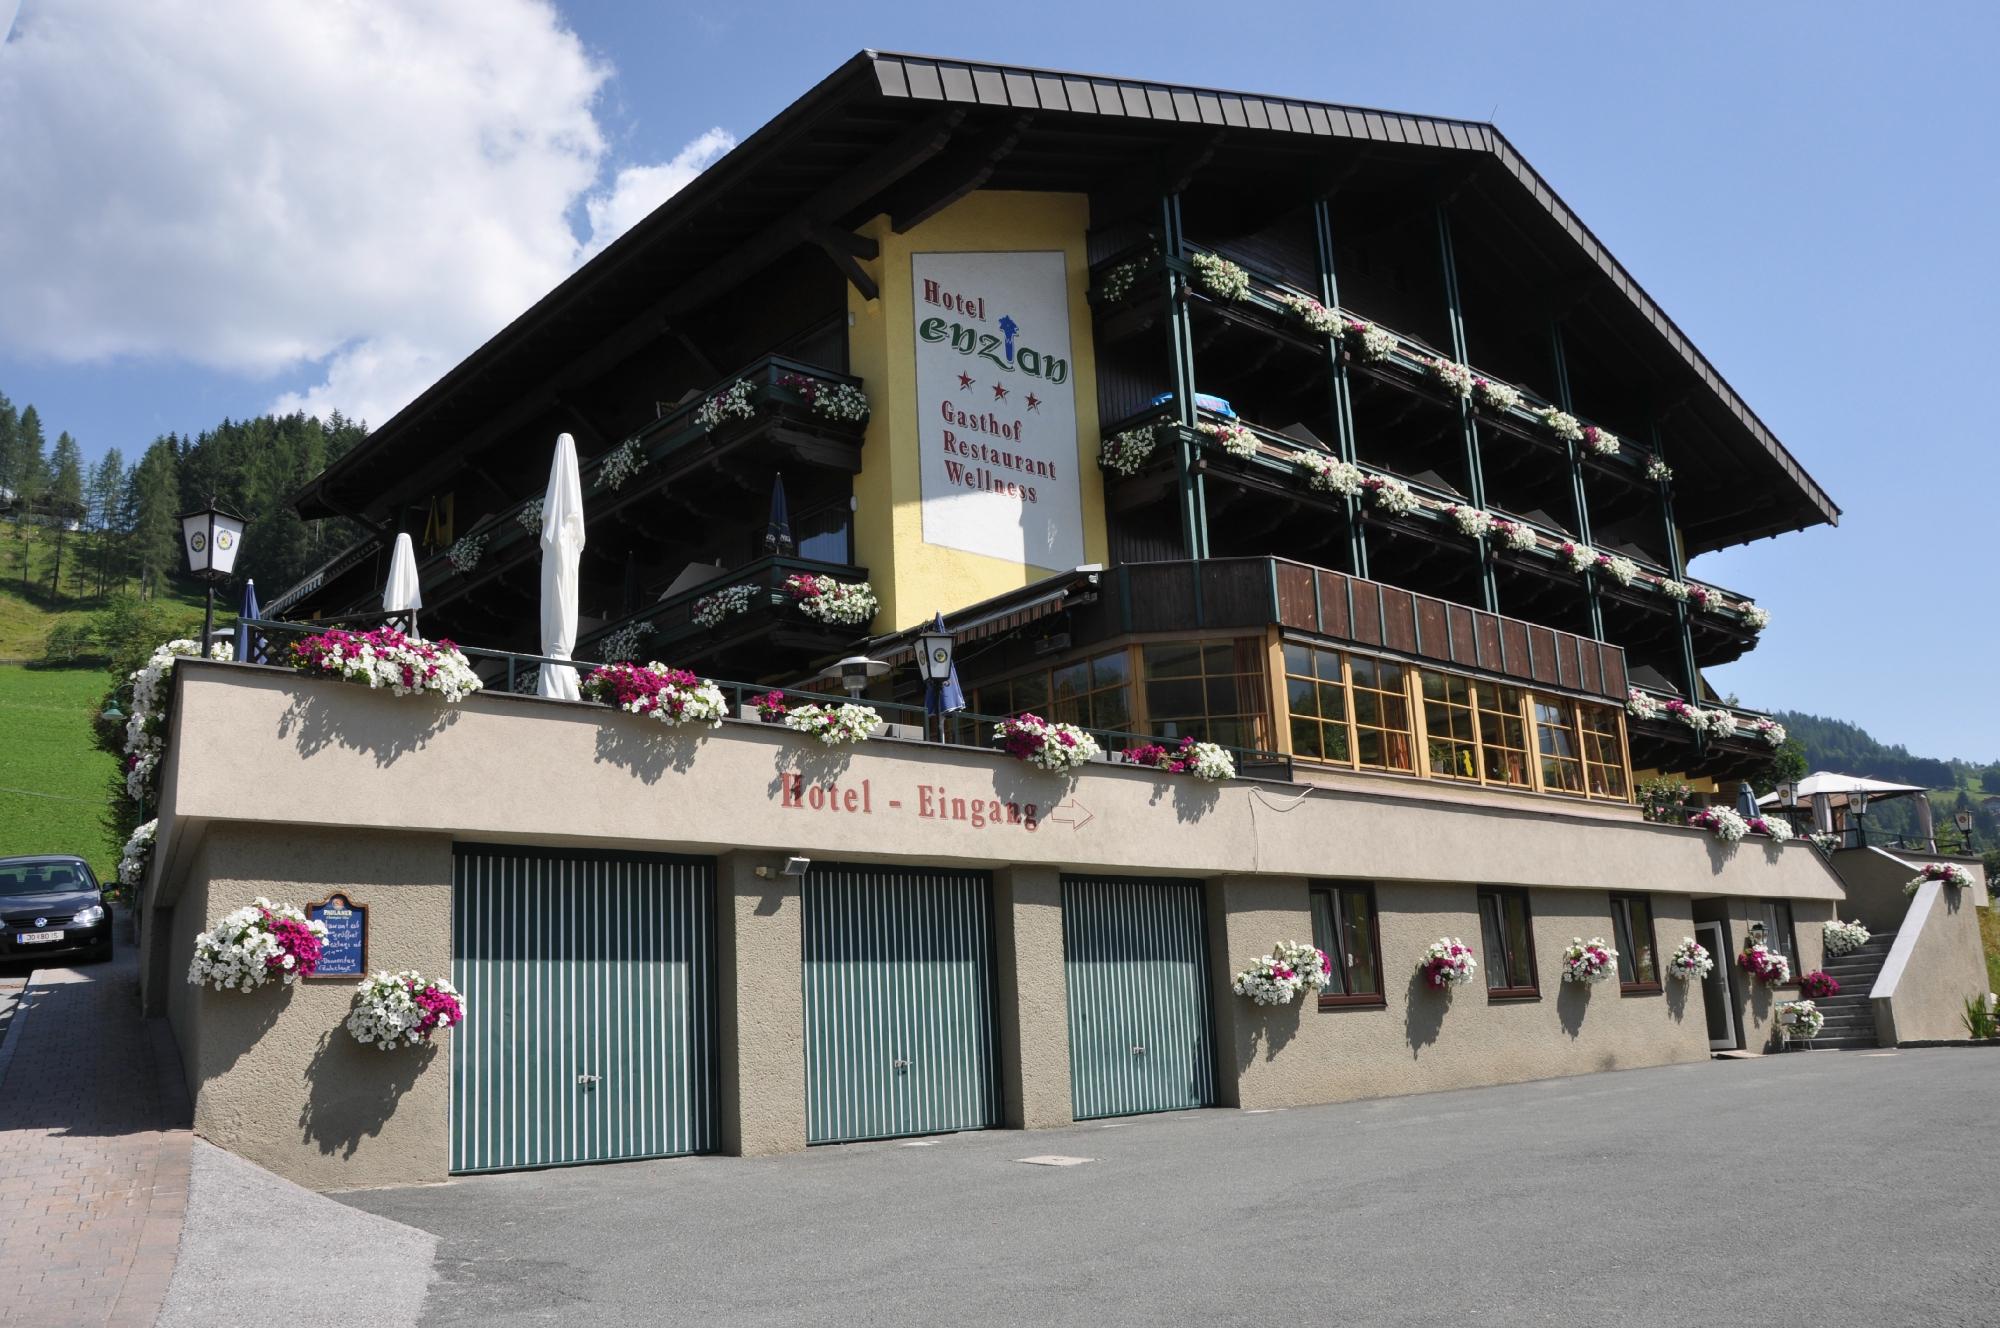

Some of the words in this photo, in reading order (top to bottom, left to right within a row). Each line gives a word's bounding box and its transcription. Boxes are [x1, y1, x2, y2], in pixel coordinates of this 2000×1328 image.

[923, 278, 986, 320] Hotel
[941, 400, 1023, 442] Gasthof
[943, 430, 1057, 480] Restaurant
[944, 459, 1038, 503] Wellness
[780, 772, 872, 815] Hotel
[917, 784, 1039, 833] Eingang
